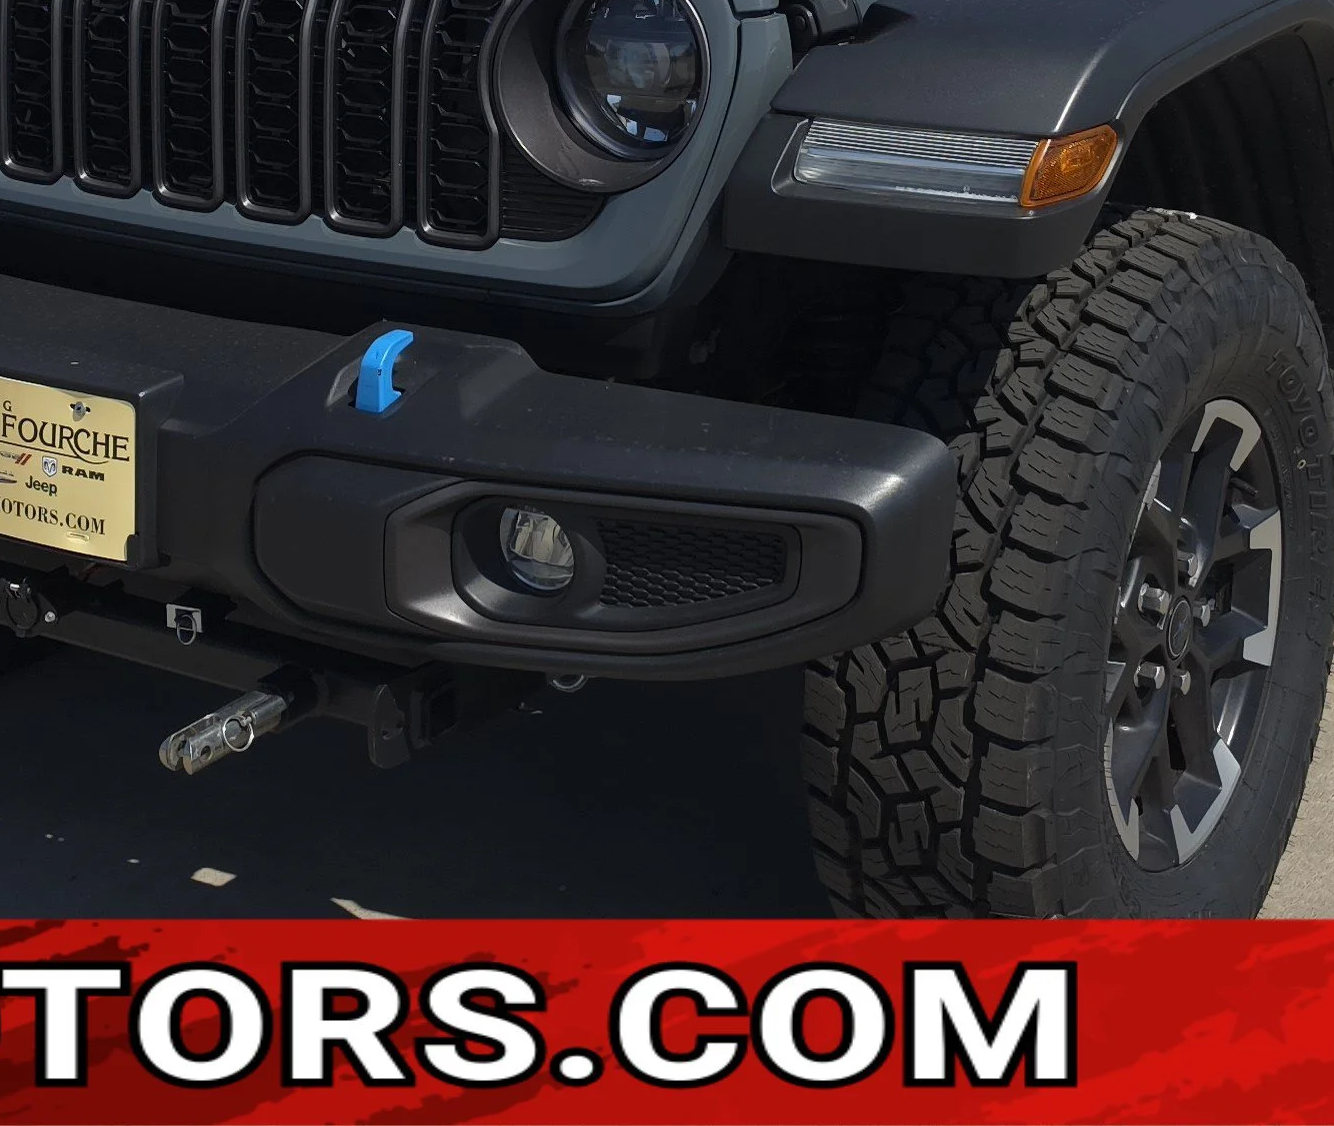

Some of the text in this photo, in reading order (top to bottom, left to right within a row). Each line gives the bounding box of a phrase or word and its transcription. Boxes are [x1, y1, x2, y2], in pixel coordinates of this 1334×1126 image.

[2, 413, 130, 465] FOURCHE
[61, 464, 105, 482] RAM
[25, 474, 58, 497] Jeep
